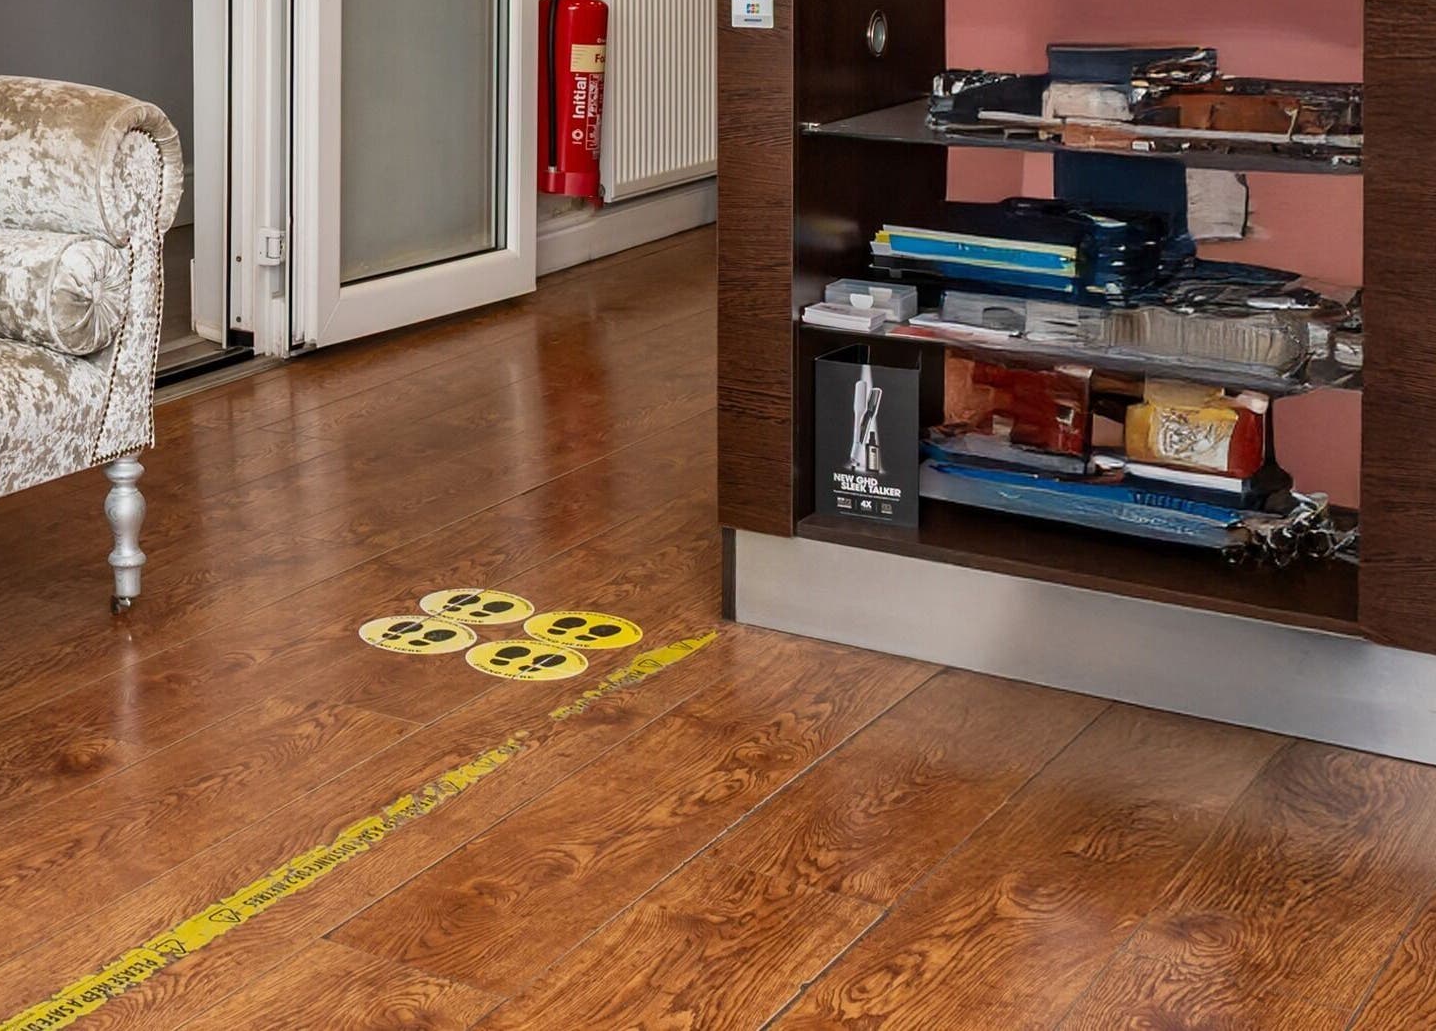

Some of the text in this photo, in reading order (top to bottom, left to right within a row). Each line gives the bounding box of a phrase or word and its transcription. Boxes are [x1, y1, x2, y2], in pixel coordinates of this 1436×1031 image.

[573, 75, 587, 119] Initial
[833, 472, 878, 486] NEW GHD
[841, 481, 866, 493] SLEEK
[868, 485, 902, 497] TALKER
[860, 499, 873, 509] 4X
[107, 958, 158, 984] PLEASE
[69, 998, 83, 1008] A
[36, 1005, 75, 1027] SAFE
